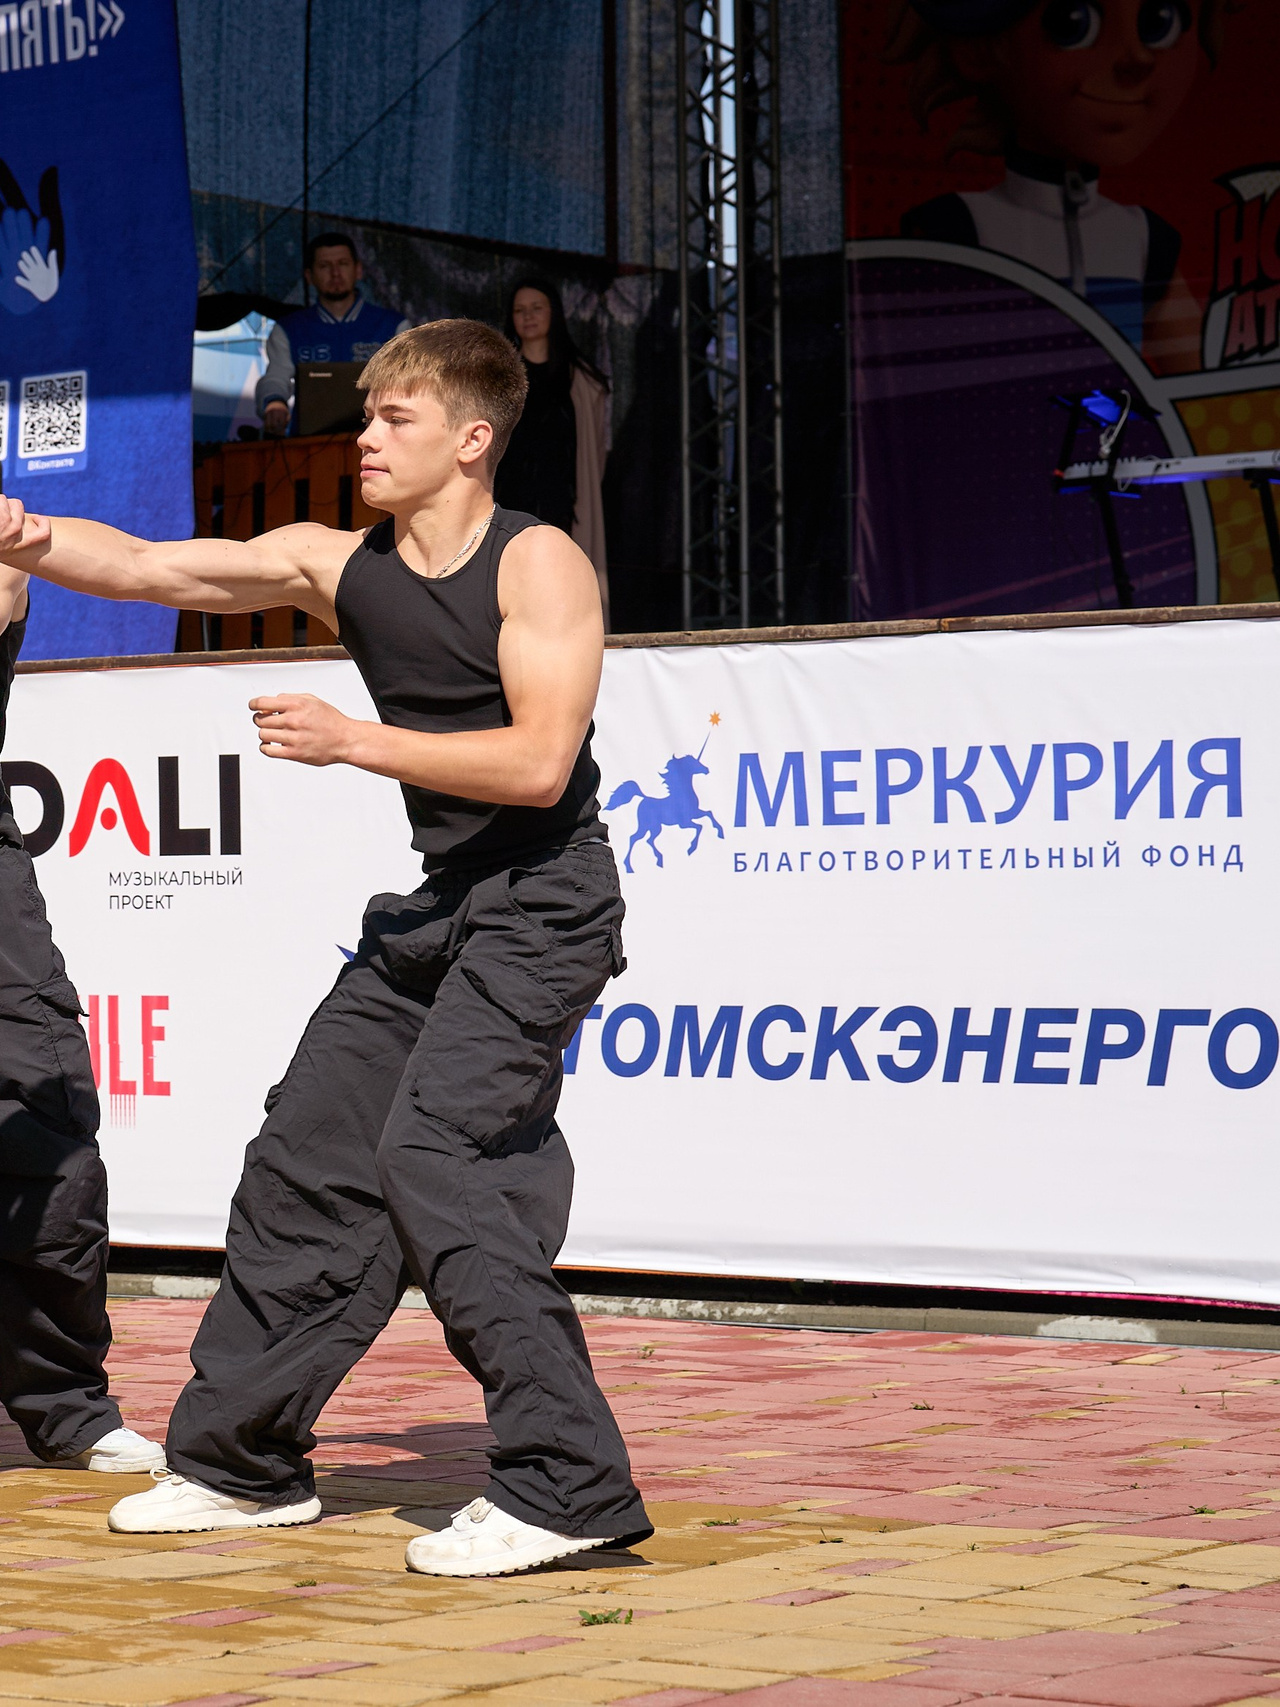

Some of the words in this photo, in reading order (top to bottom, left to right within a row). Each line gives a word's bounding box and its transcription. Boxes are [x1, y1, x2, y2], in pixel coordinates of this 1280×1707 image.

[733, 737, 1244, 828] МЕРКУРИЯ
[733, 840, 1121, 874] БЛАГОТВОРИТЕЛЬНЫЙ
[1141, 843, 1245, 873] ФОНД
[108, 866, 244, 887] МУЗЫКАЛЬНЫЙ
[108, 894, 175, 910] ПРОЕКТ
